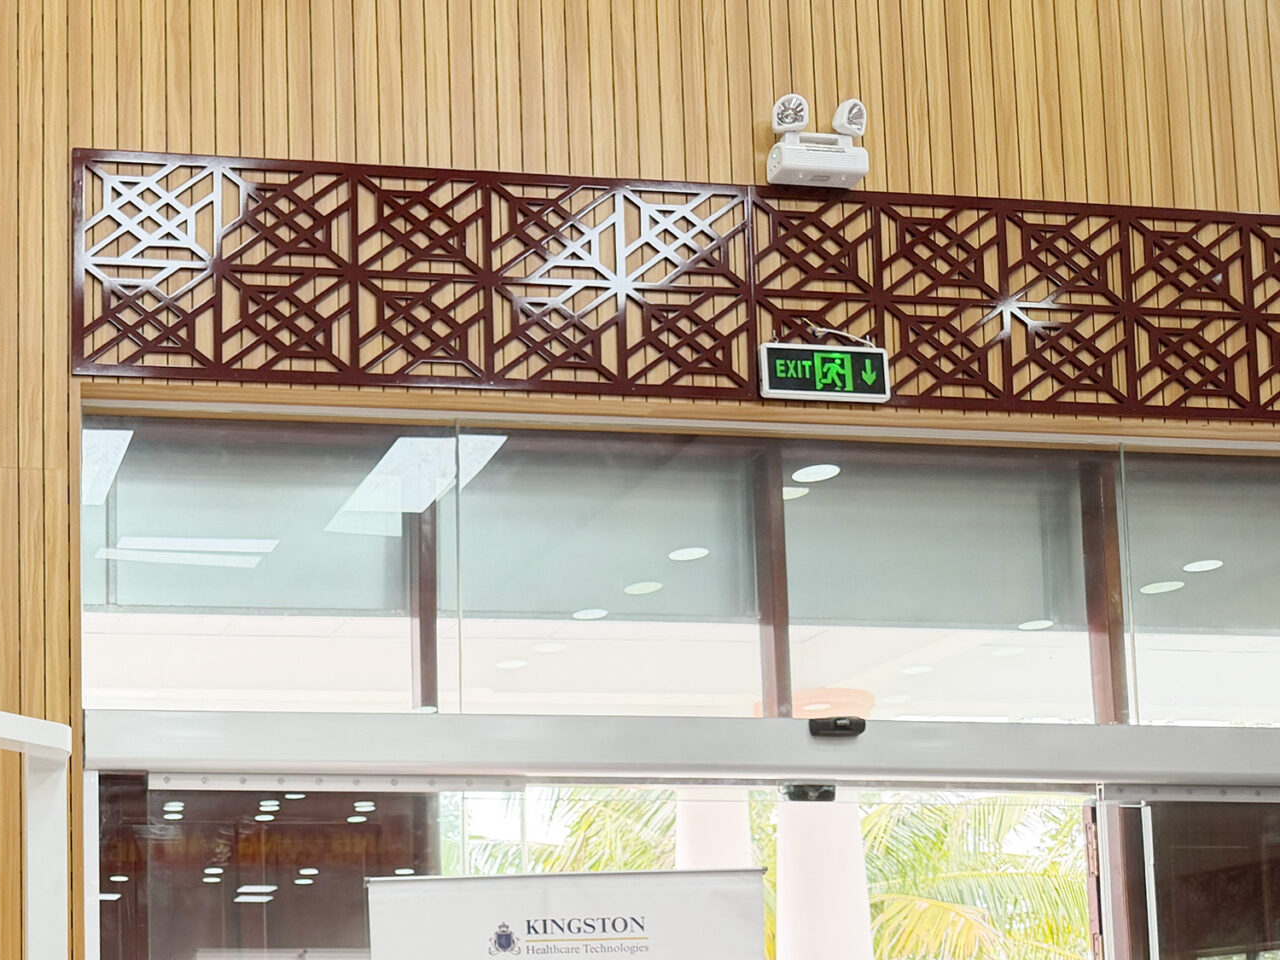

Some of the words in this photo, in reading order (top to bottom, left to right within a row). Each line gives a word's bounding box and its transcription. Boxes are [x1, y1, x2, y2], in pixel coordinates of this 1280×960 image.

[775, 359, 812, 379] EXIT
[525, 916, 645, 935] KINGSTON
[526, 944, 581, 955] Healthcare
[582, 943, 649, 955] Technologies
